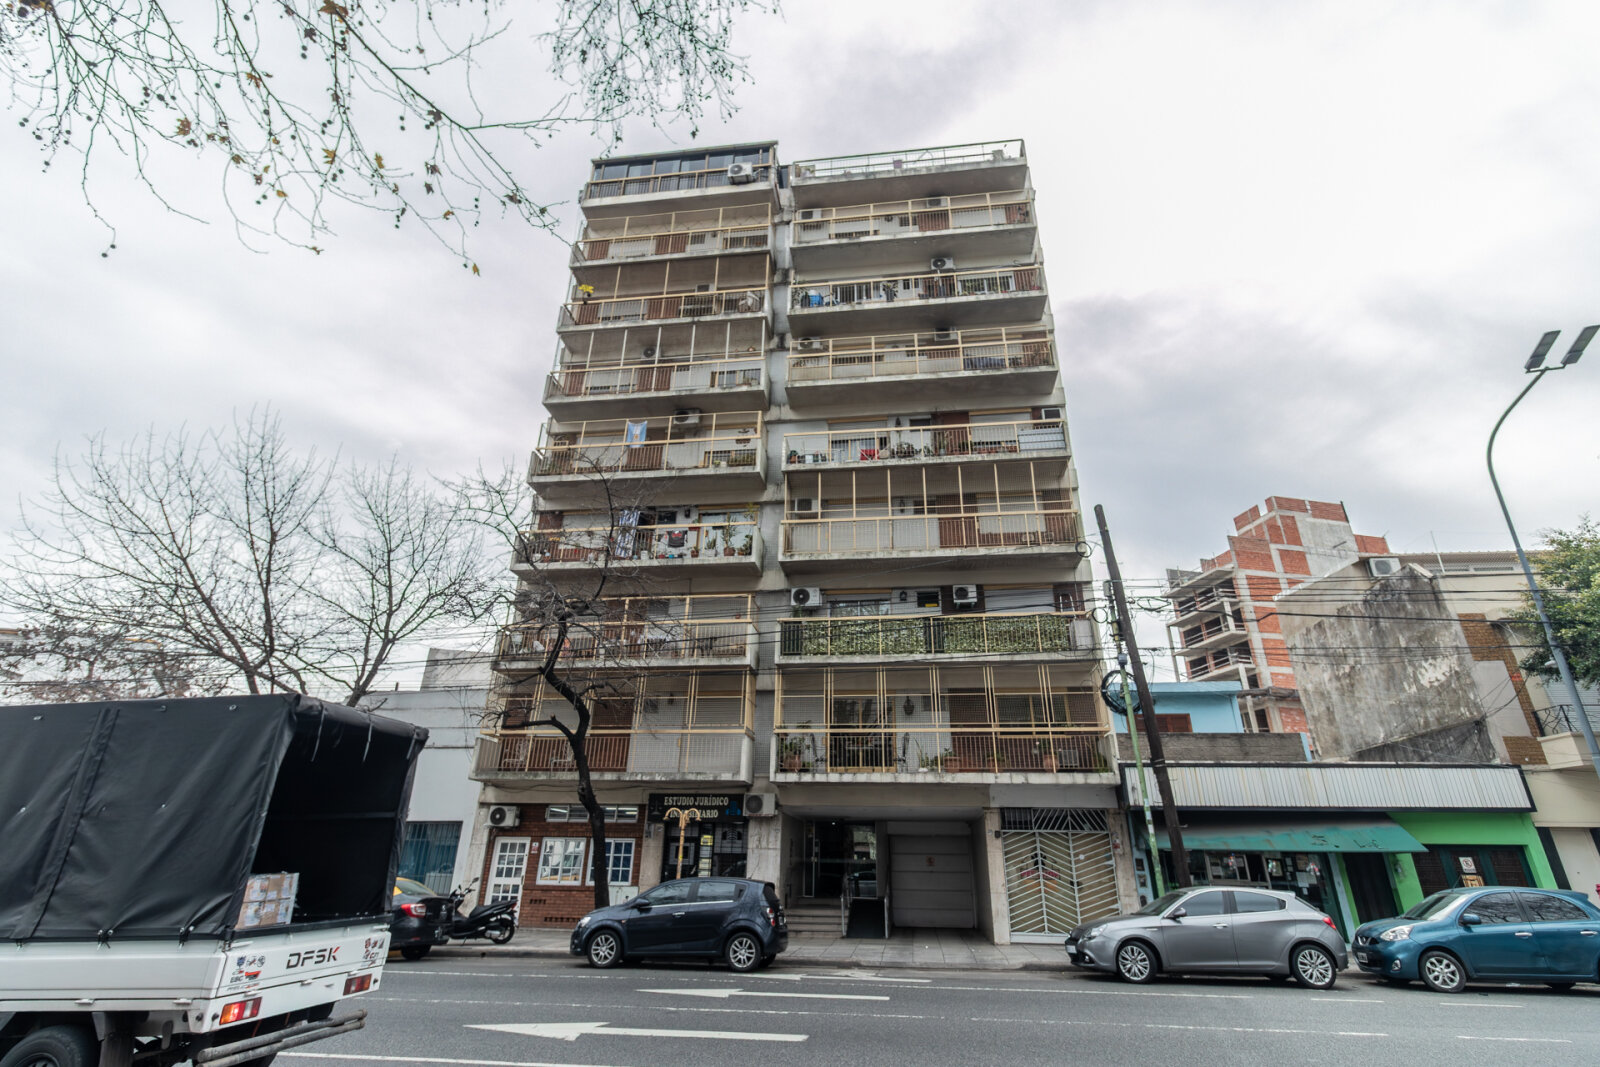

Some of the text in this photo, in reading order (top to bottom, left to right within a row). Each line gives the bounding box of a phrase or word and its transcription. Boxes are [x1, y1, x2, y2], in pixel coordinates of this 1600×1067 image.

[664, 794, 729, 806] ESTUDIO JURÍDICO
[286, 946, 341, 969] DFSK
